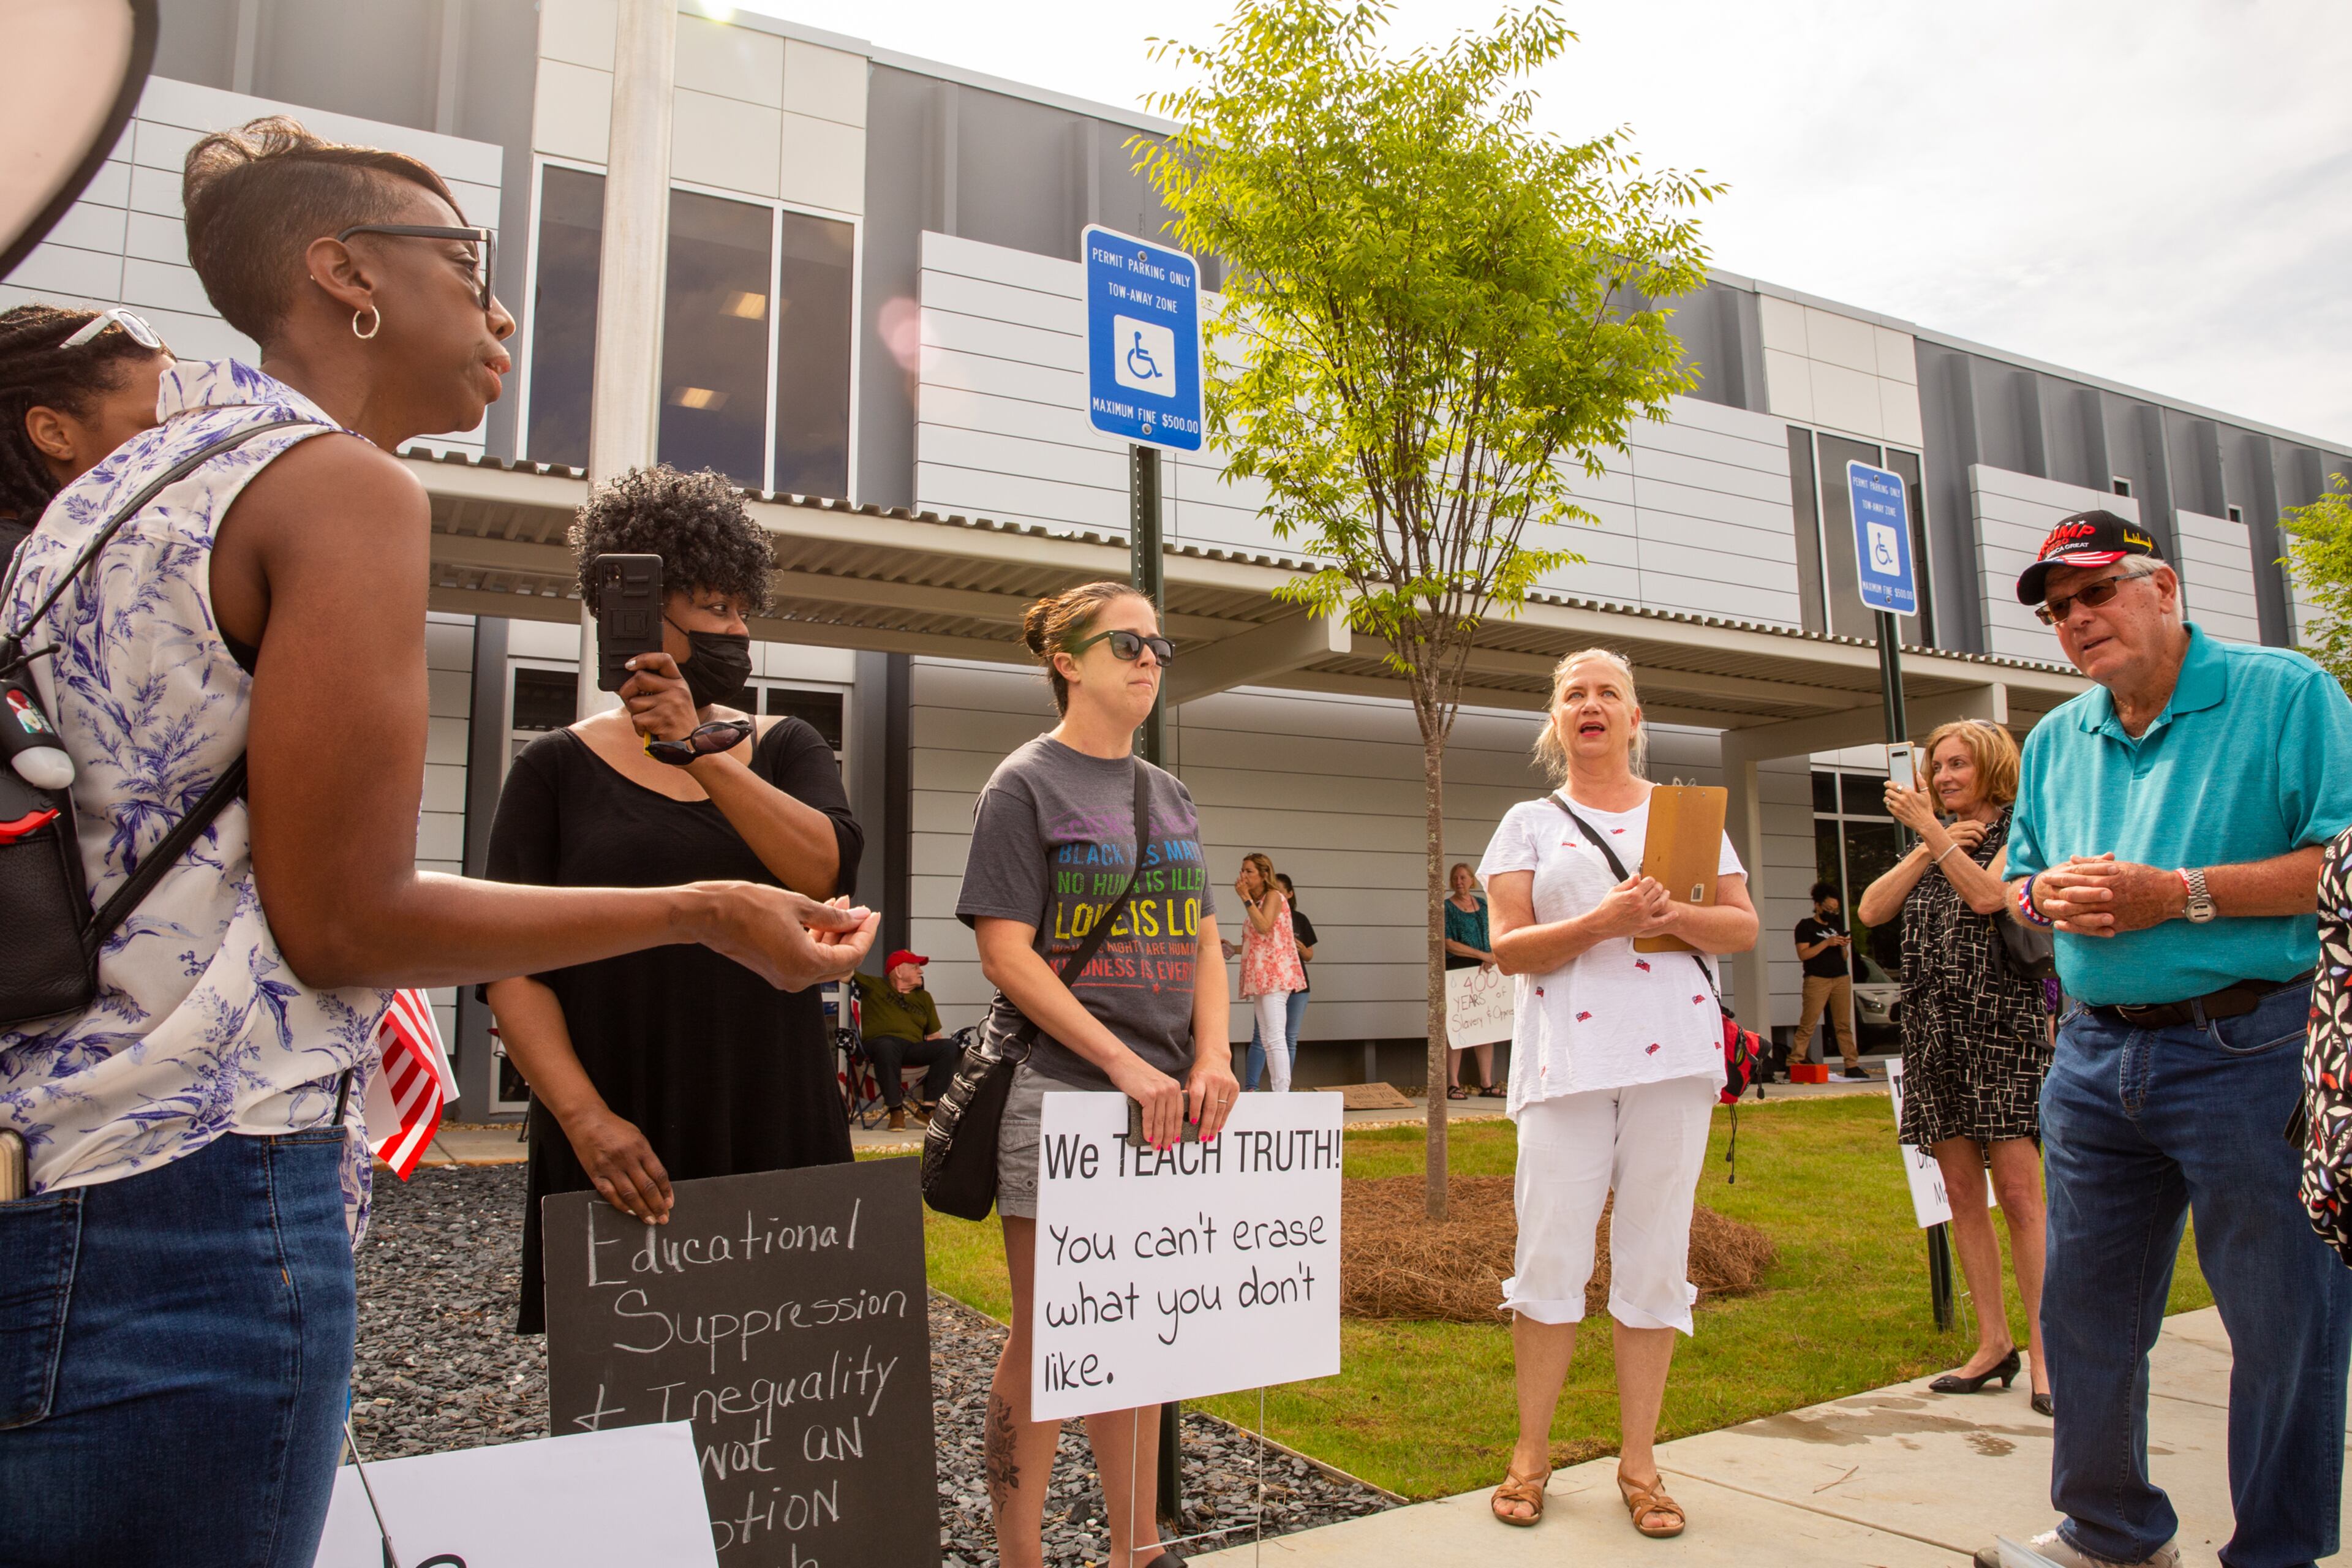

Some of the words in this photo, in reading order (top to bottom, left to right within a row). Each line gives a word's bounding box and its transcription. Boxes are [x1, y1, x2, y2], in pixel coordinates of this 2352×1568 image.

[1092, 247, 1123, 268] PERMIT
[1128, 258, 1165, 281] PARKING
[1170, 271, 1190, 288] ONLY
[1108, 282, 1153, 307] TOW-AWAY
[1156, 295, 1177, 314] ZONE
[1093, 396, 1133, 419] MAXIMUM
[1138, 407, 1156, 425] FINE
[1162, 413, 1199, 434] $500.00
[1852, 476, 1868, 489] PERMIT
[1869, 481, 1888, 495] PARKING
[1890, 487, 1901, 498] ONLY
[1862, 499, 1884, 513] TOW-AWAY
[1885, 505, 1896, 517] ZONE
[1862, 581, 1882, 594] MAXIMUM
[1883, 585, 1893, 596] FINE
[1894, 587, 1913, 600] $500.00
[1058, 843, 1125, 866] BLACK
[1057, 870, 1085, 895] NO
[1146, 869, 1165, 892] IS
[1129, 899, 1159, 937] IS
[1146, 941, 1167, 956] ARE
[1140, 959, 1155, 979] IS
[1463, 970, 1499, 993] 400
[1453, 992, 1486, 1012] YEARS
[1496, 986, 1507, 999] of
[1452, 1014, 1483, 1033] Slavery
[1044, 1134, 1099, 1180] We
[1112, 1132, 1222, 1177] TEACH
[1233, 1129, 1341, 1173] TRUTH!
[587, 1197, 862, 1287] Educational
[1049, 1224, 1116, 1266] You
[1134, 1211, 1217, 1258] can't
[1233, 1215, 1327, 1251] erase
[1046, 1281, 1140, 1328] what
[1157, 1284, 1222, 1346] you
[1238, 1261, 1315, 1308] don't
[612, 1287, 908, 1374] Suppression
[1044, 1351, 1114, 1392] like.
[647, 1344, 899, 1436] Inequality
